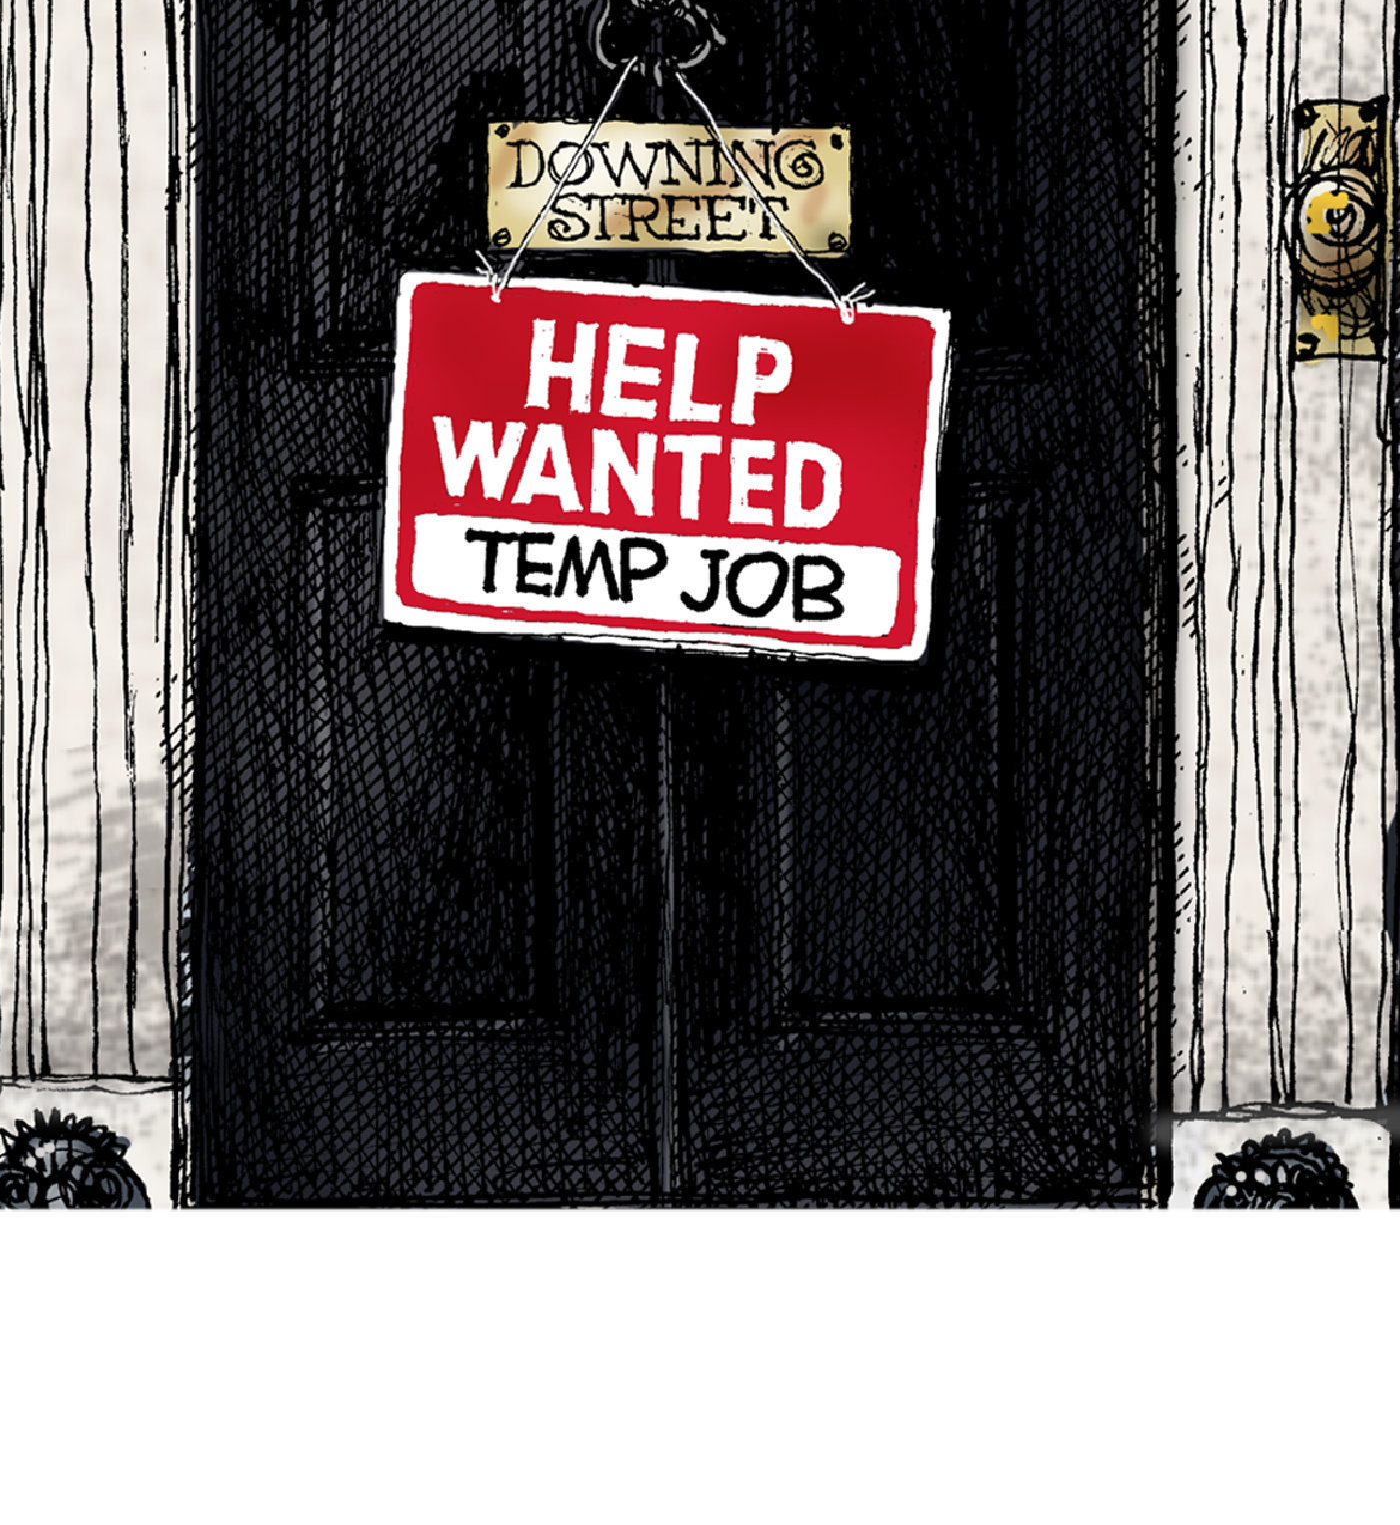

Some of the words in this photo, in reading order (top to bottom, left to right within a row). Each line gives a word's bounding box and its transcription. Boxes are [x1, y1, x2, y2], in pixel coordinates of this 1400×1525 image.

[504, 139, 826, 191] DOWNING
[546, 192, 791, 242] STREET
[523, 318, 793, 426] HELP
[432, 415, 843, 530] WANTED
[465, 530, 669, 604] TEMP
[680, 548, 846, 623] JOB
